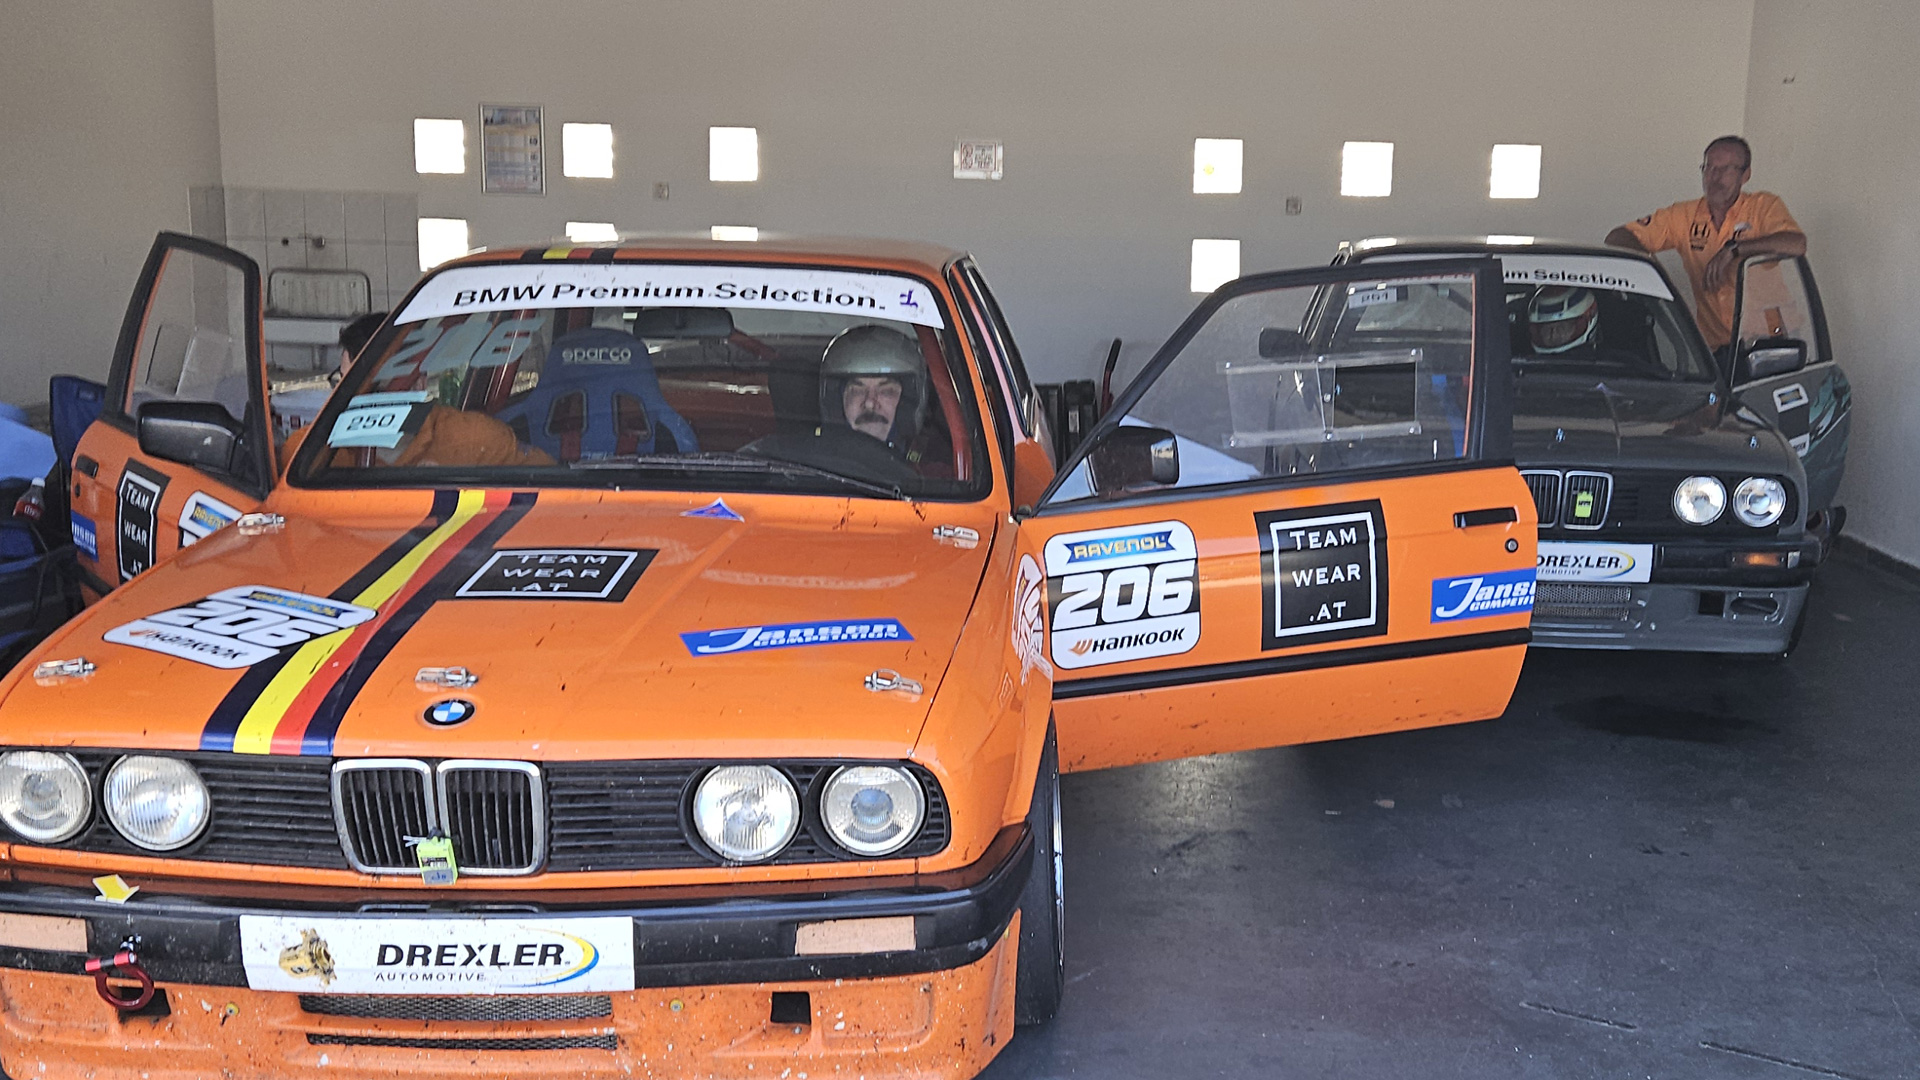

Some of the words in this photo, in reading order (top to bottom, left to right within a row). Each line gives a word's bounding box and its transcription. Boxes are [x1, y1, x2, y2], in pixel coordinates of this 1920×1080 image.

[1534, 268, 1636, 289] Selection.
[453, 283, 545, 307] BMW
[552, 281, 703, 299] Premium
[715, 283, 886, 310] Selection.
[562, 347, 631, 364] sparco
[346, 413, 396, 431] 250
[125, 483, 150, 510] TEAM
[124, 519, 147, 547] WEAR
[1289, 527, 1357, 550] TEAM
[1073, 535, 1167, 559] RAVENOL
[518, 554, 608, 565] TEAM
[503, 568, 600, 578] WEAR
[1291, 563, 1361, 588] WEAR
[1052, 559, 1196, 631] 206
[1309, 601, 1347, 622] .AT
[145, 600, 338, 648] 206
[377, 943, 566, 967] DREXLER
[375, 972, 485, 982] AUTOMOTIVE
